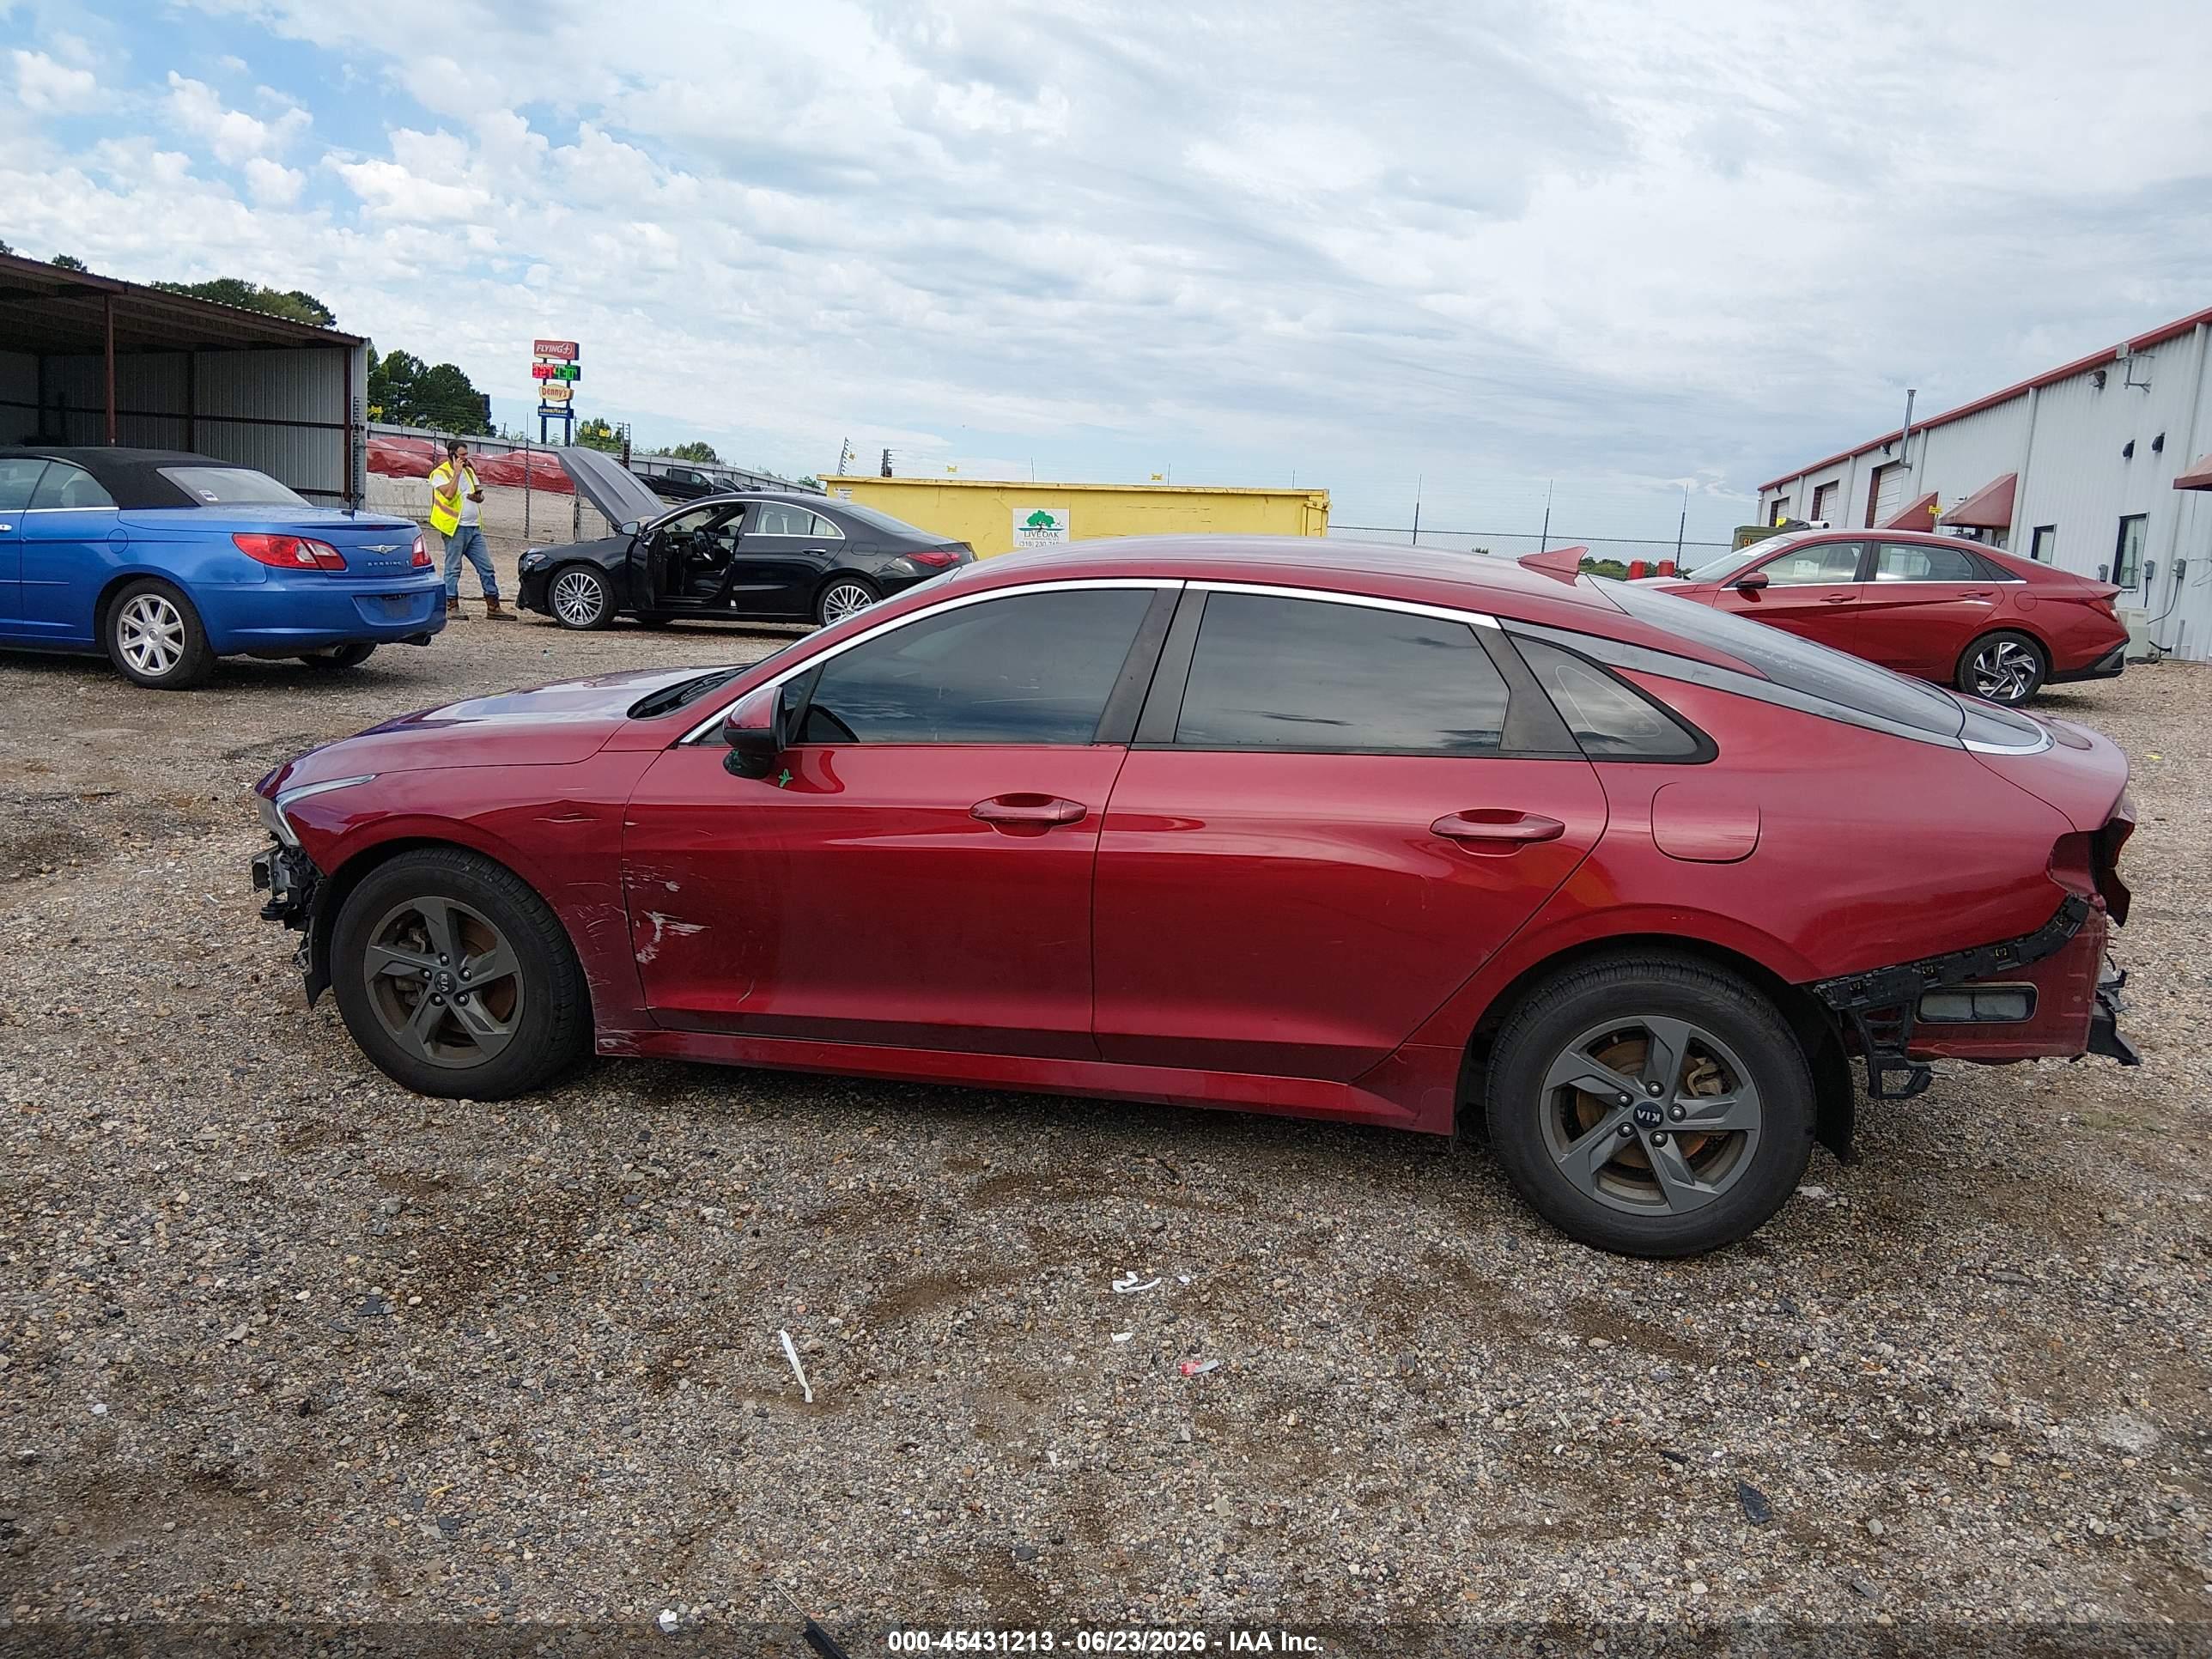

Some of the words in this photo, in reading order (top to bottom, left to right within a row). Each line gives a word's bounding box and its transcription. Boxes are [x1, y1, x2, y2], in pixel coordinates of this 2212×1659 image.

[536, 344, 562, 353] FLYING
[542, 387, 567, 398] Denny's
[1637, 1109, 1661, 1122] KIA
